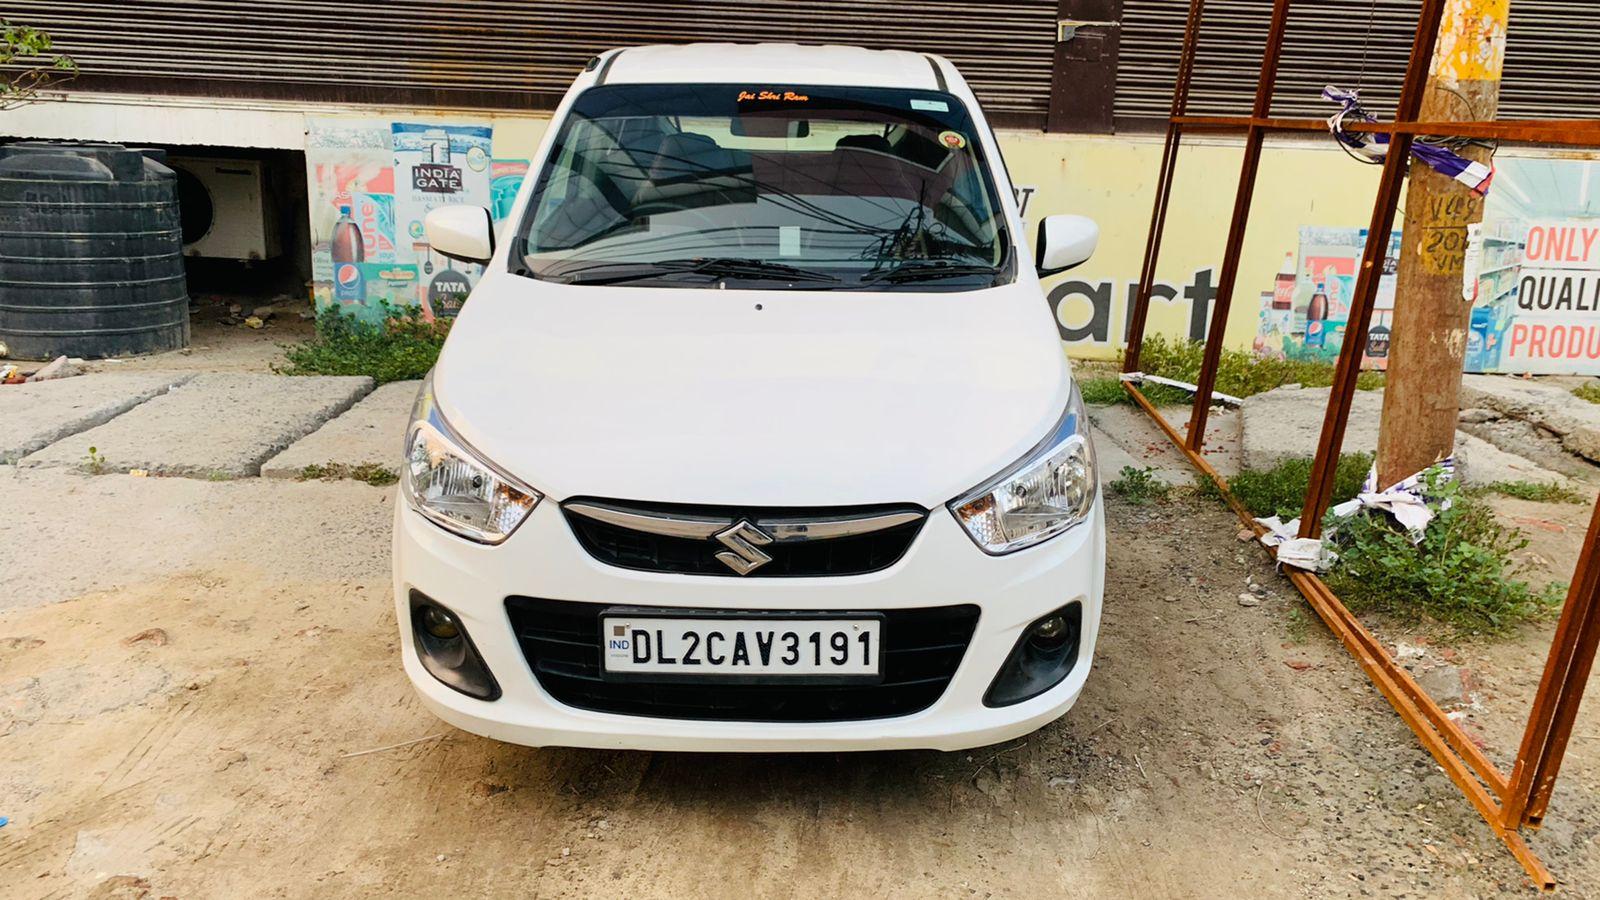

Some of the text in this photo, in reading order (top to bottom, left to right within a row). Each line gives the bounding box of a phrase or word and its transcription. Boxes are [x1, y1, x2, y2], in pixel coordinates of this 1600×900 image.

[737, 90, 809, 102] Jai Shri Ram
[415, 168, 460, 179] INDIA
[416, 178, 459, 189] GATE
[1525, 225, 1599, 262] ONLY
[435, 281, 467, 292] TATA
[1369, 333, 1390, 341] TATA
[1509, 324, 1600, 360] PRODU
[609, 639, 630, 650] IND
[631, 629, 871, 666] DL2CAV3191
